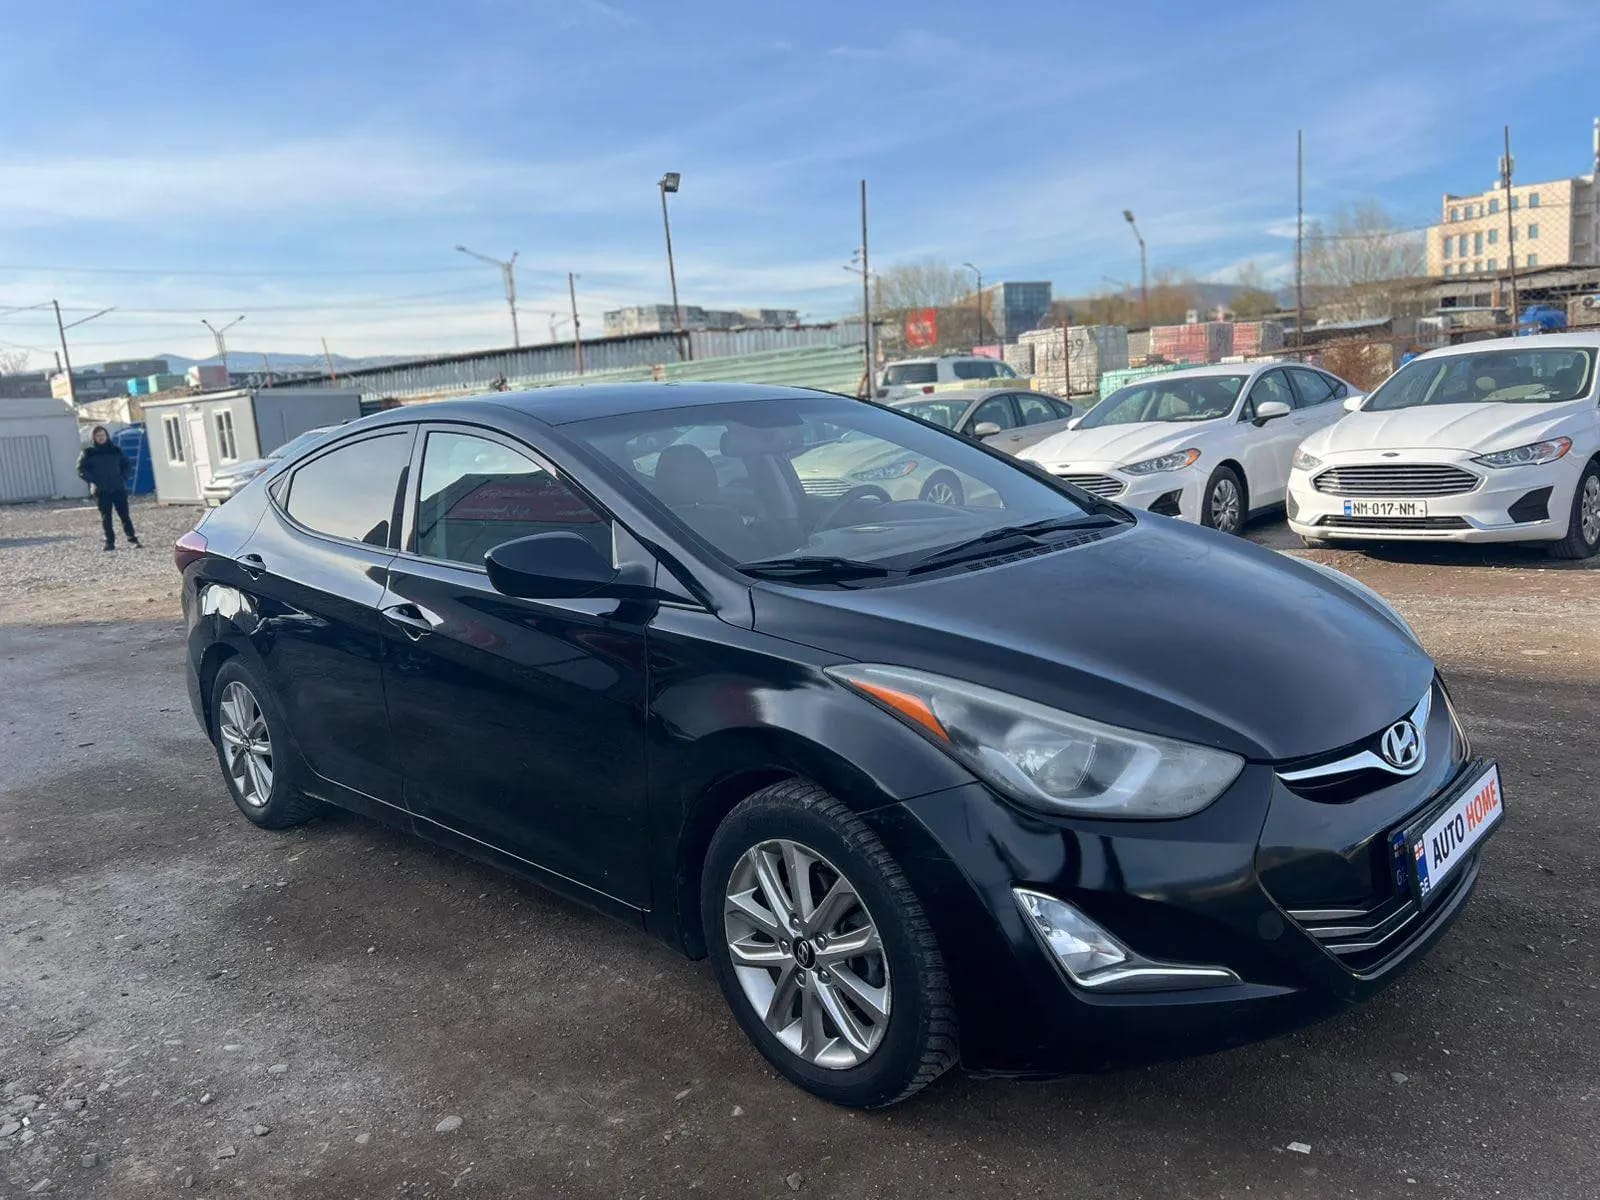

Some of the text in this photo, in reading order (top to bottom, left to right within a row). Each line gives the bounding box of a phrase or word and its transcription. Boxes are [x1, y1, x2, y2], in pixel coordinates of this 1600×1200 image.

[1353, 502, 1416, 515] NM-017-NM
[1432, 779, 1498, 869] AUTO HOME
